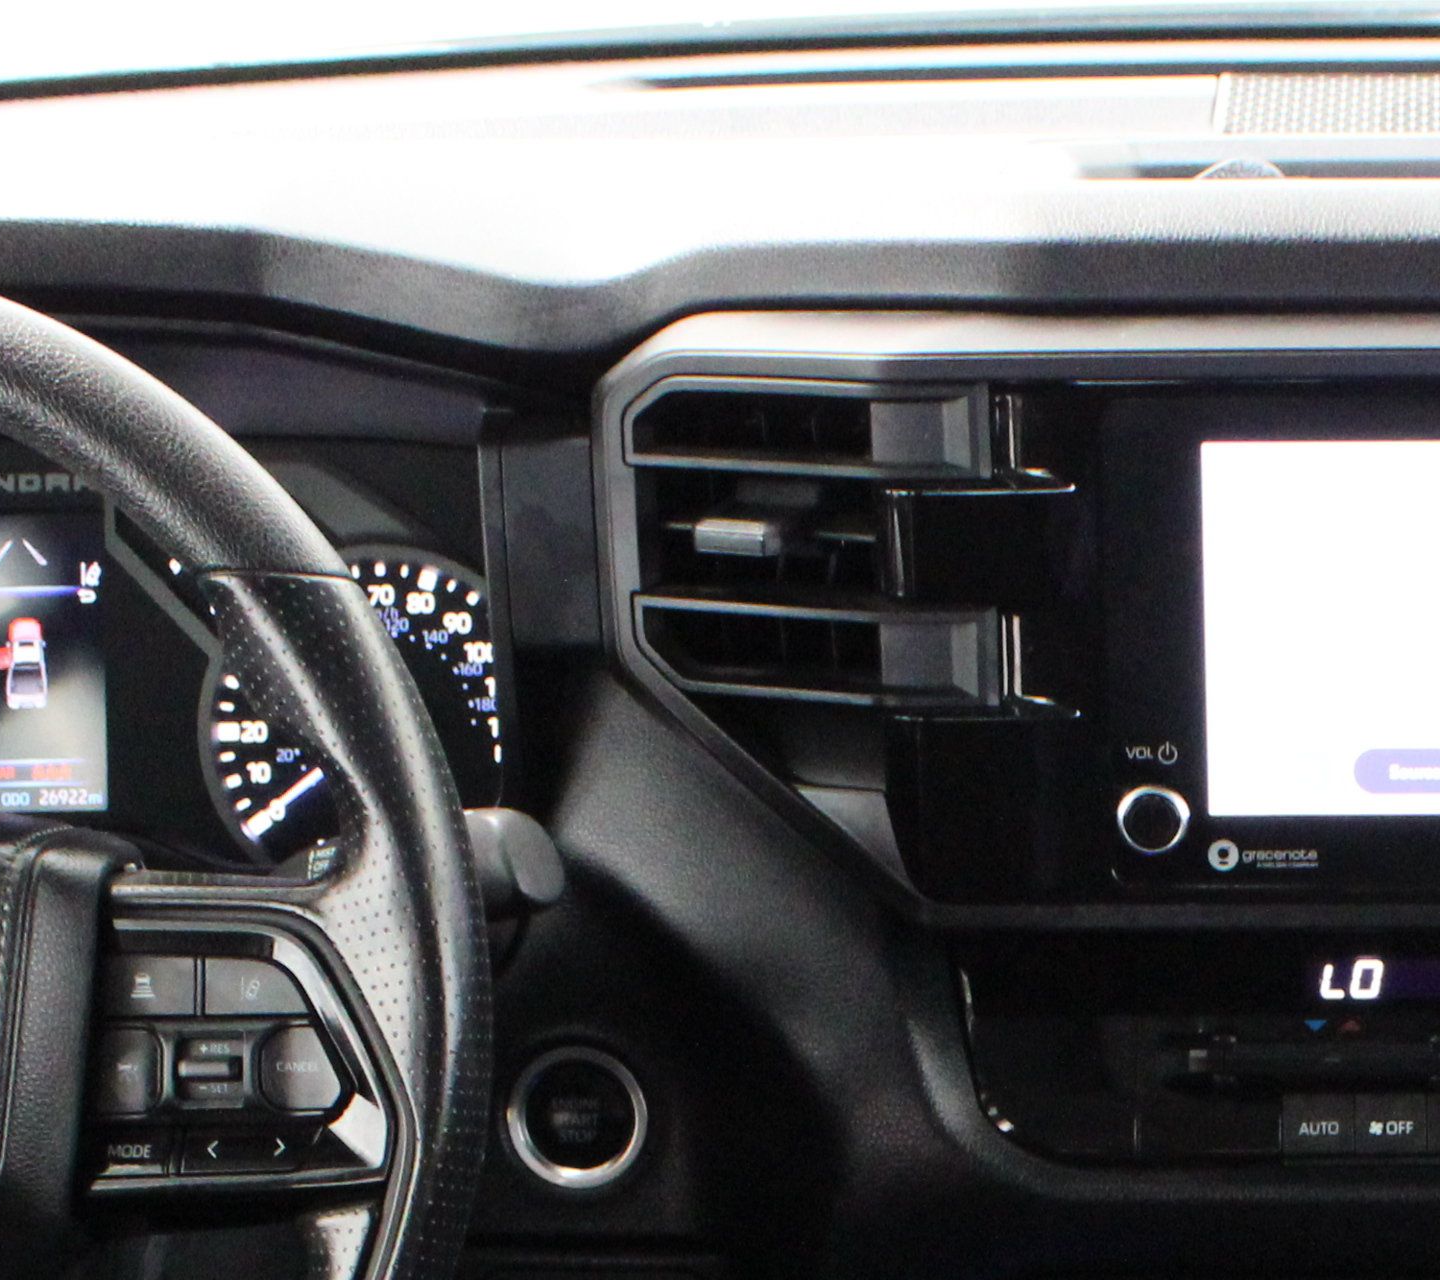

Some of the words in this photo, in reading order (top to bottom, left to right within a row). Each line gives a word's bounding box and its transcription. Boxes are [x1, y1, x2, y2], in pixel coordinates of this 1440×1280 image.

[367, 583, 395, 607] 70
[406, 591, 435, 614] 80
[386, 616, 409, 633] 120
[442, 611, 472, 635] 90
[423, 629, 448, 645] 140
[457, 663, 483, 676] 160
[239, 720, 268, 744] 20
[1125, 746, 1153, 760] VOL
[246, 760, 272, 785] 10
[1, 791, 30, 806] ODO
[1241, 849, 1318, 864] gracenote
[1298, 1120, 1340, 1136] AUTO
[1385, 1120, 1414, 1136] OFF
[107, 1143, 152, 1159] MODE
